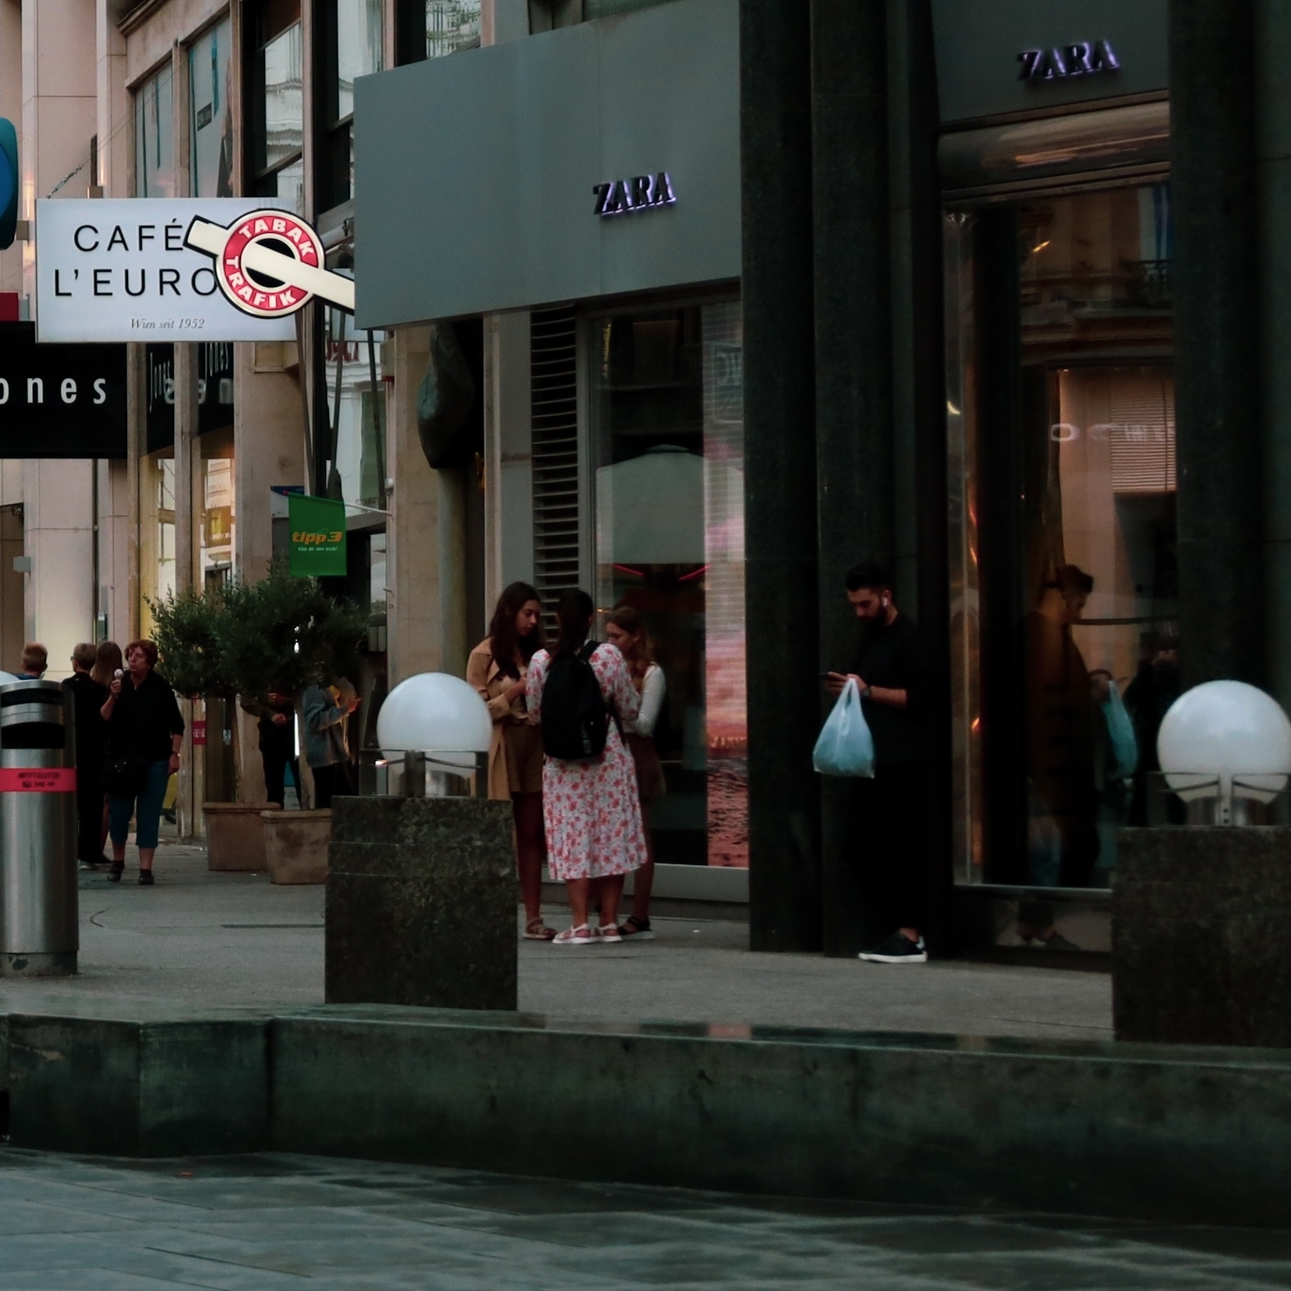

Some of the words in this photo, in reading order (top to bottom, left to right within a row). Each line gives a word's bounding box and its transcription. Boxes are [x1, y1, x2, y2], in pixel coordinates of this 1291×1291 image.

[1016, 40, 1119, 81] ZARA
[592, 171, 677, 216] ZARA
[74, 218, 184, 252] CAFÉ
[239, 218, 315, 257] TABAK
[54, 267, 217, 297] L'EURO
[226, 256, 297, 309] TRAFIK
[131, 318, 156, 330] Wien
[158, 319, 175, 330] seit
[178, 318, 205, 330] 1952
